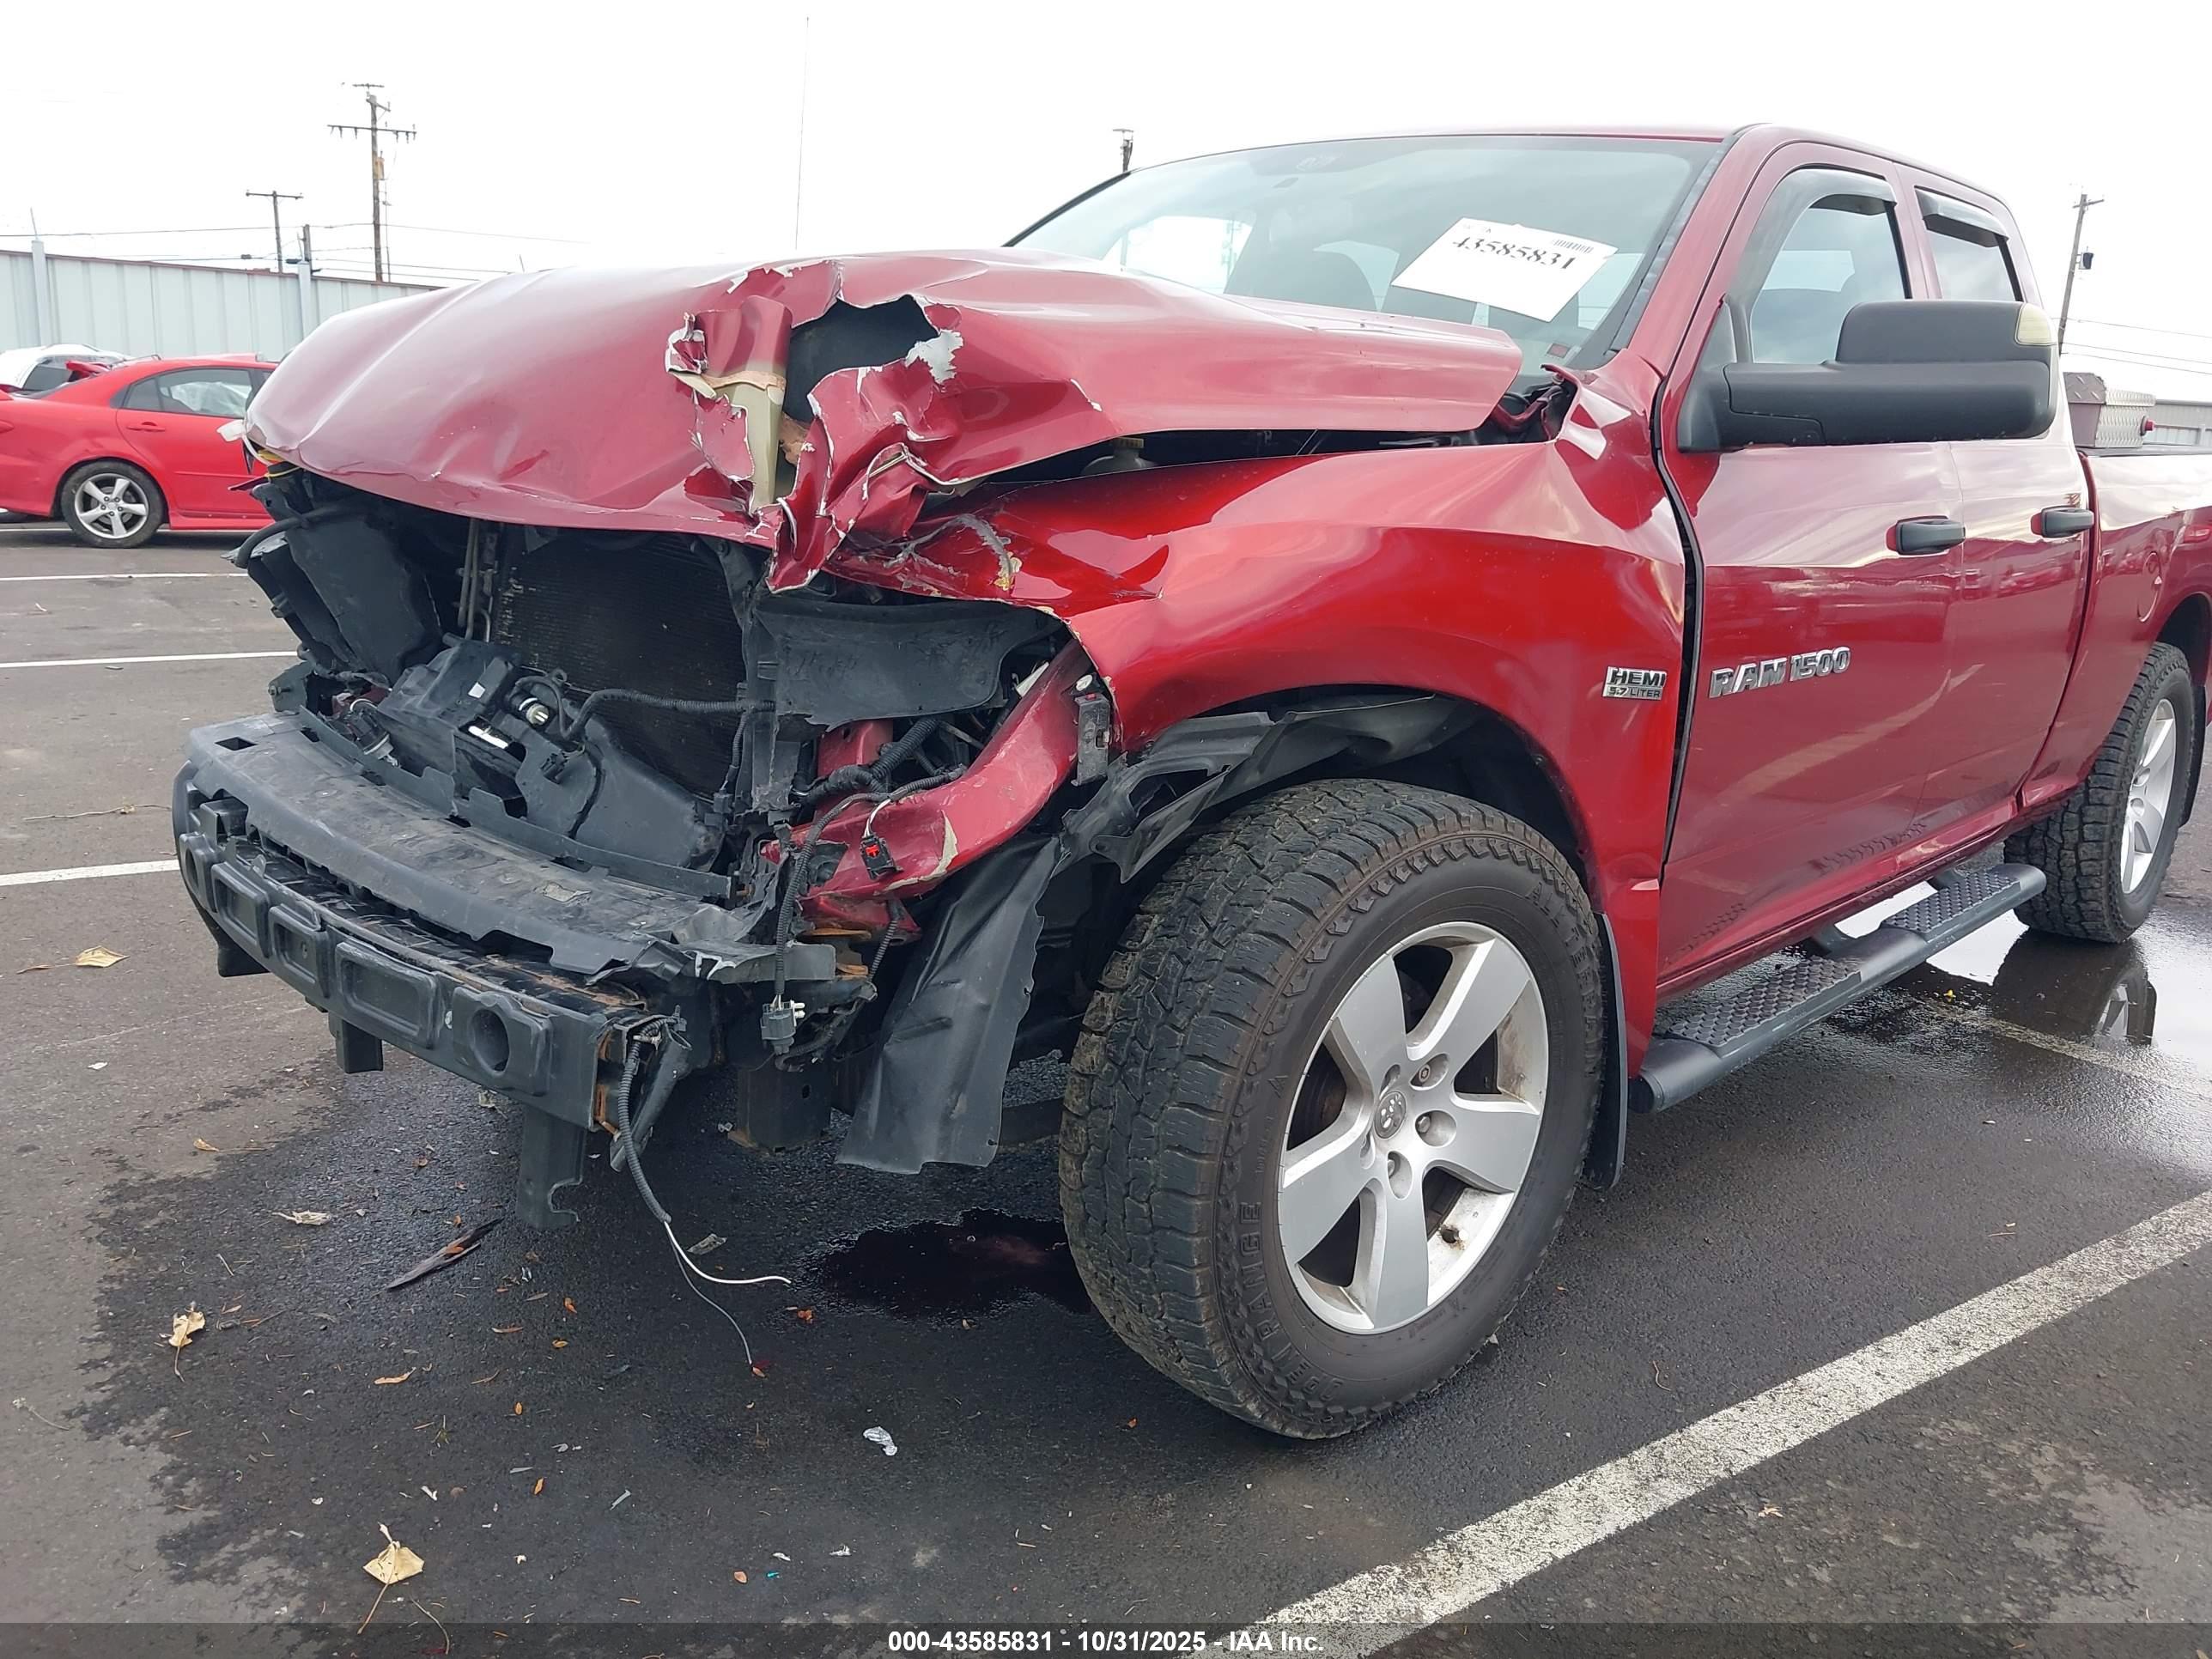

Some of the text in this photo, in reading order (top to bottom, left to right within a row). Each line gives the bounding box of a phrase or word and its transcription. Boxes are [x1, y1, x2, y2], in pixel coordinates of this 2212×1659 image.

[1452, 236, 1577, 270] 43585831
[1610, 667, 1667, 687] HEMI
[1709, 646, 1850, 698] RAM 1500
[1630, 688, 1661, 698] LITER
[1239, 1201, 1281, 1341] RANGE
